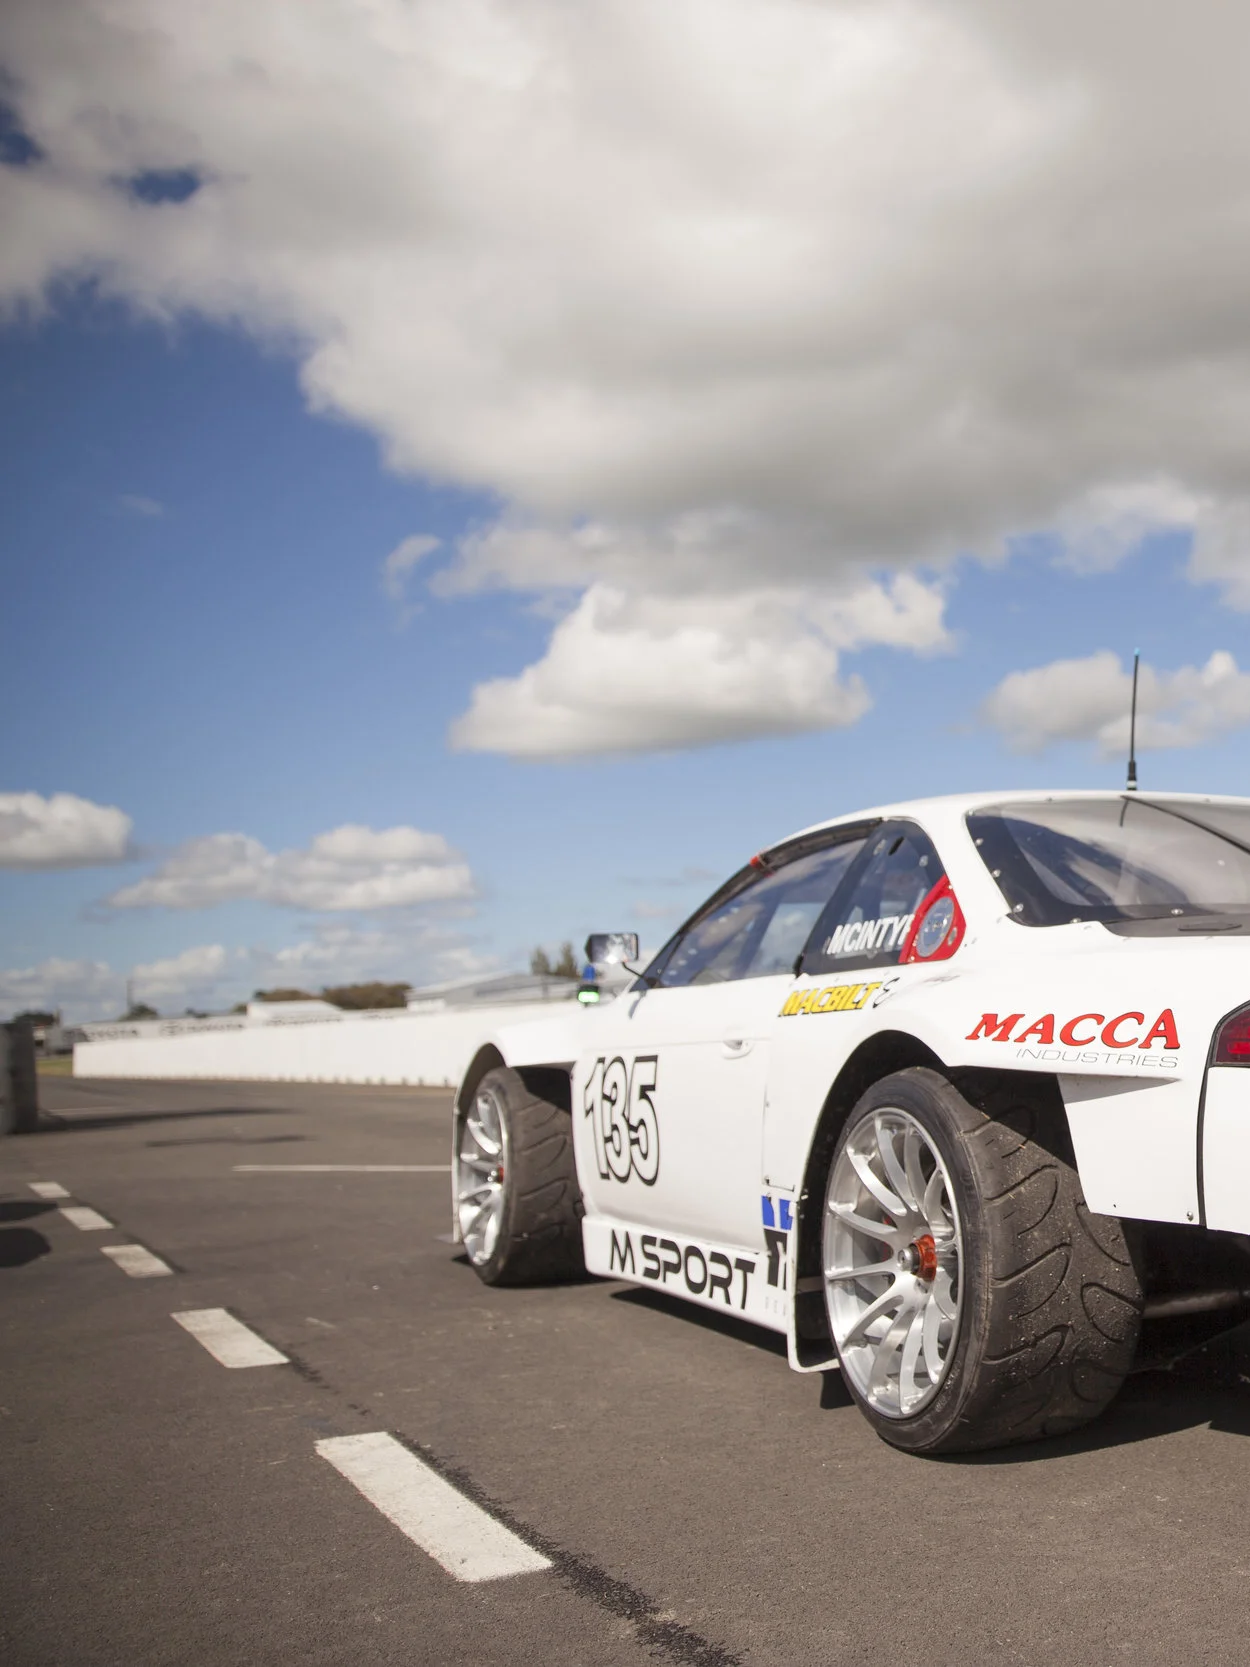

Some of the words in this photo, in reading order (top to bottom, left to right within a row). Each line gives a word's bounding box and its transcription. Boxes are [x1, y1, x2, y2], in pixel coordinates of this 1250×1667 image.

[778, 981, 883, 1017] MACBILT
[965, 1008, 1181, 1050] MACCA
[1016, 1048, 1179, 1069] INDUSTRIES
[584, 1055, 660, 1187] 135
[610, 1229, 636, 1275] M
[641, 1234, 756, 1311] SPORT
